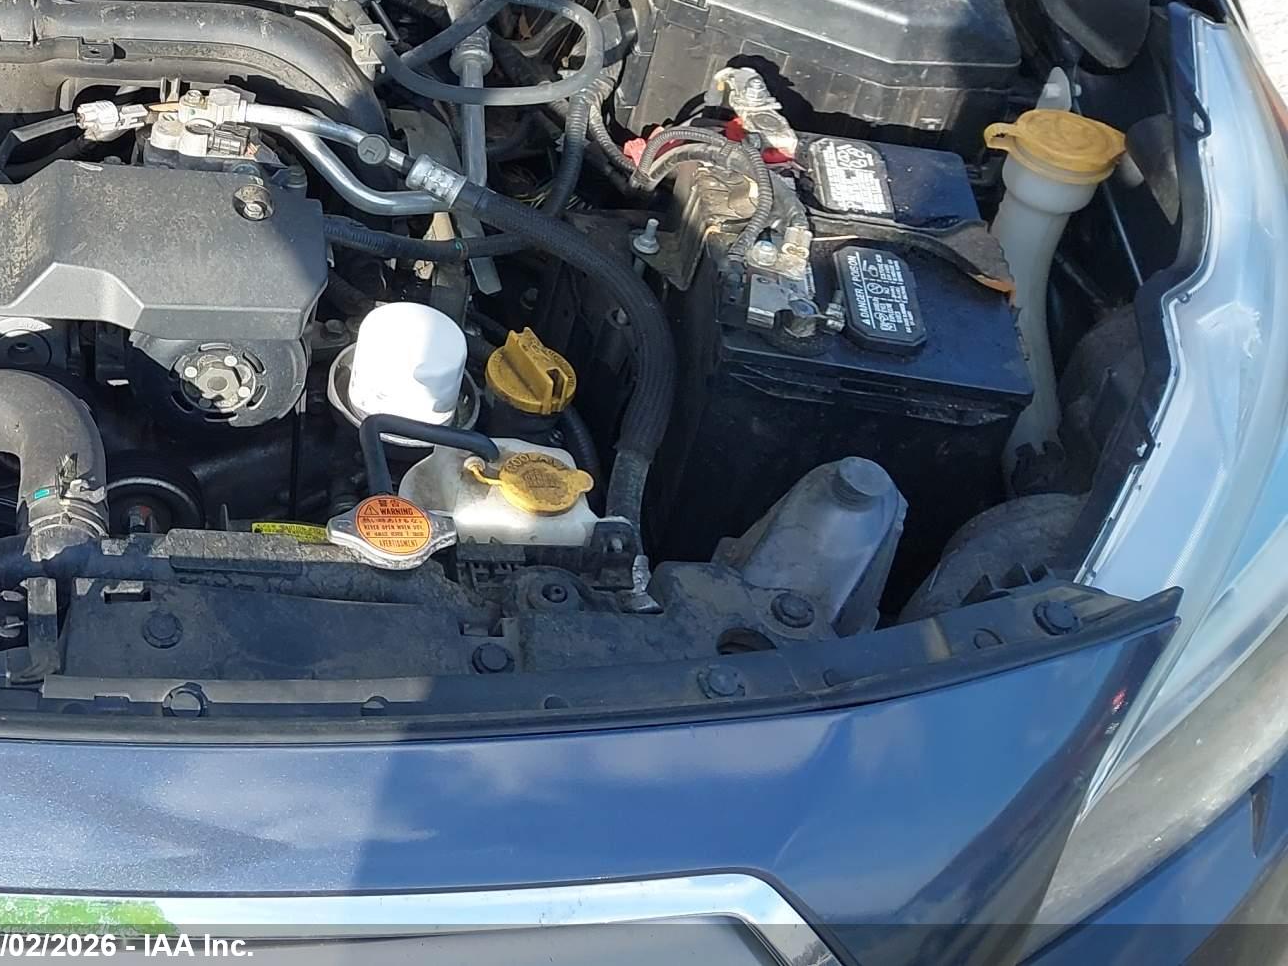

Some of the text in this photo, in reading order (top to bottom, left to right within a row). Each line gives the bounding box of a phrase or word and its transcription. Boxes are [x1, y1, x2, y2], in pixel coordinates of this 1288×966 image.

[847, 255, 862, 282] POISON
[854, 288, 869, 319] DANGER
[379, 507, 414, 516] WARNING
